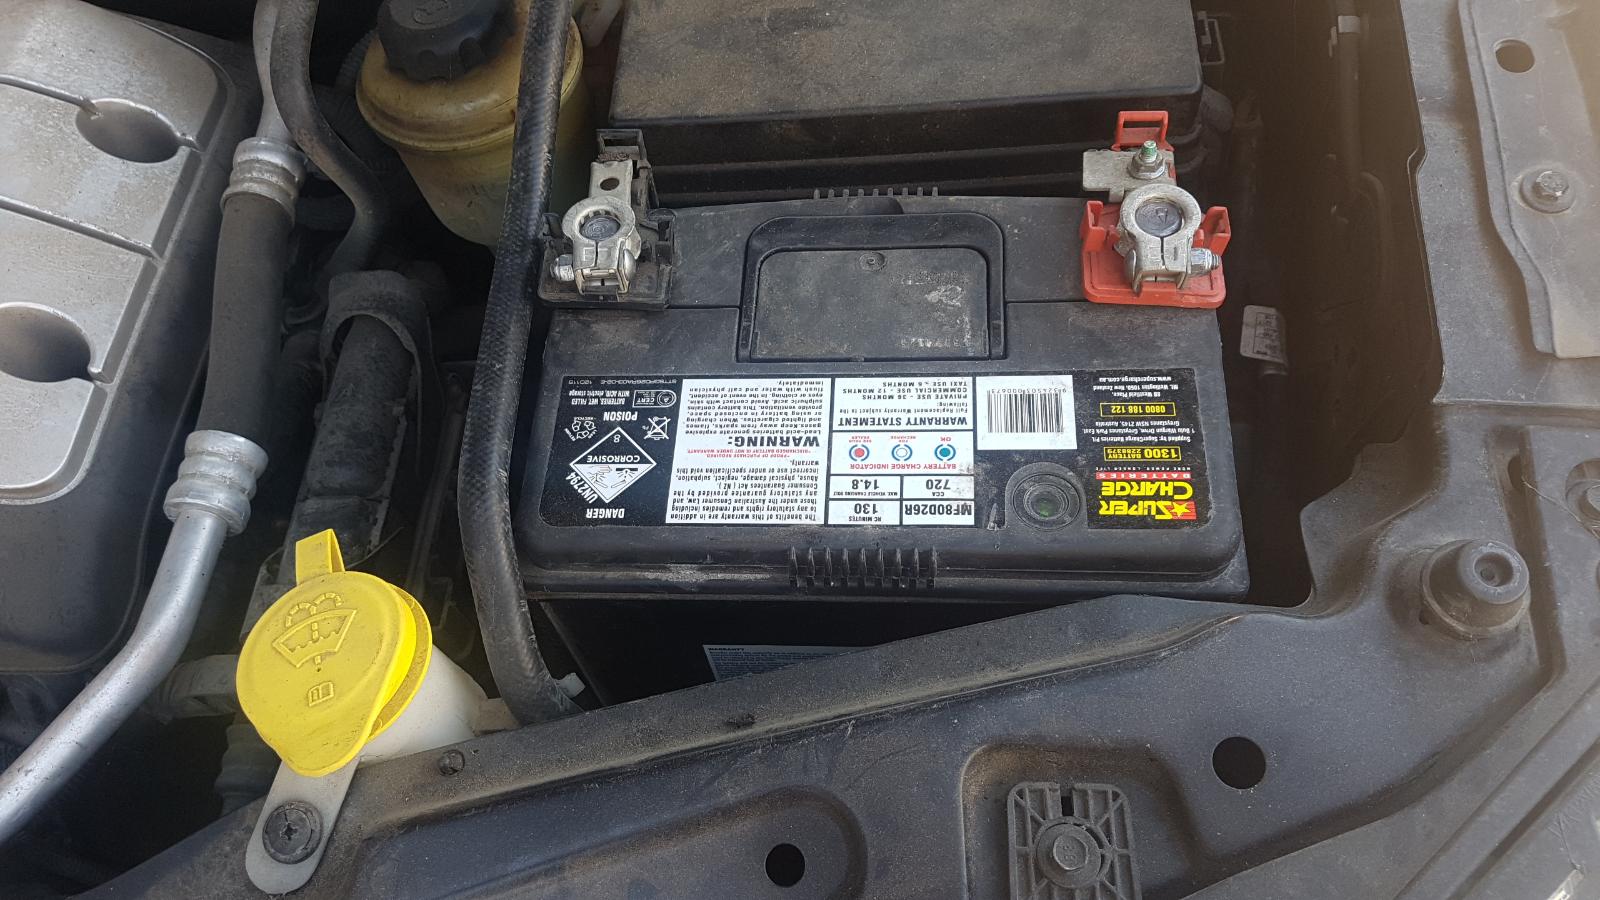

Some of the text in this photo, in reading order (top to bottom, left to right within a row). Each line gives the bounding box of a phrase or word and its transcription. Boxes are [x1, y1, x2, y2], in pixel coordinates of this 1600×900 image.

[1146, 405, 1165, 413] 0800
[603, 411, 638, 421] POISON
[838, 417, 967, 426] WARRANTY STATEMENT
[614, 434, 621, 443] 8
[728, 436, 820, 447] WARNING:
[1144, 449, 1178, 458] 1300
[565, 472, 598, 503] UN2794
[852, 479, 880, 489] 14.8
[926, 479, 951, 490] 720
[1101, 481, 1193, 500] CHARGE
[586, 508, 625, 518] DANGER
[854, 503, 878, 514] 130
[905, 503, 972, 515] MF80D26R
[1099, 500, 1173, 520] SUPER
